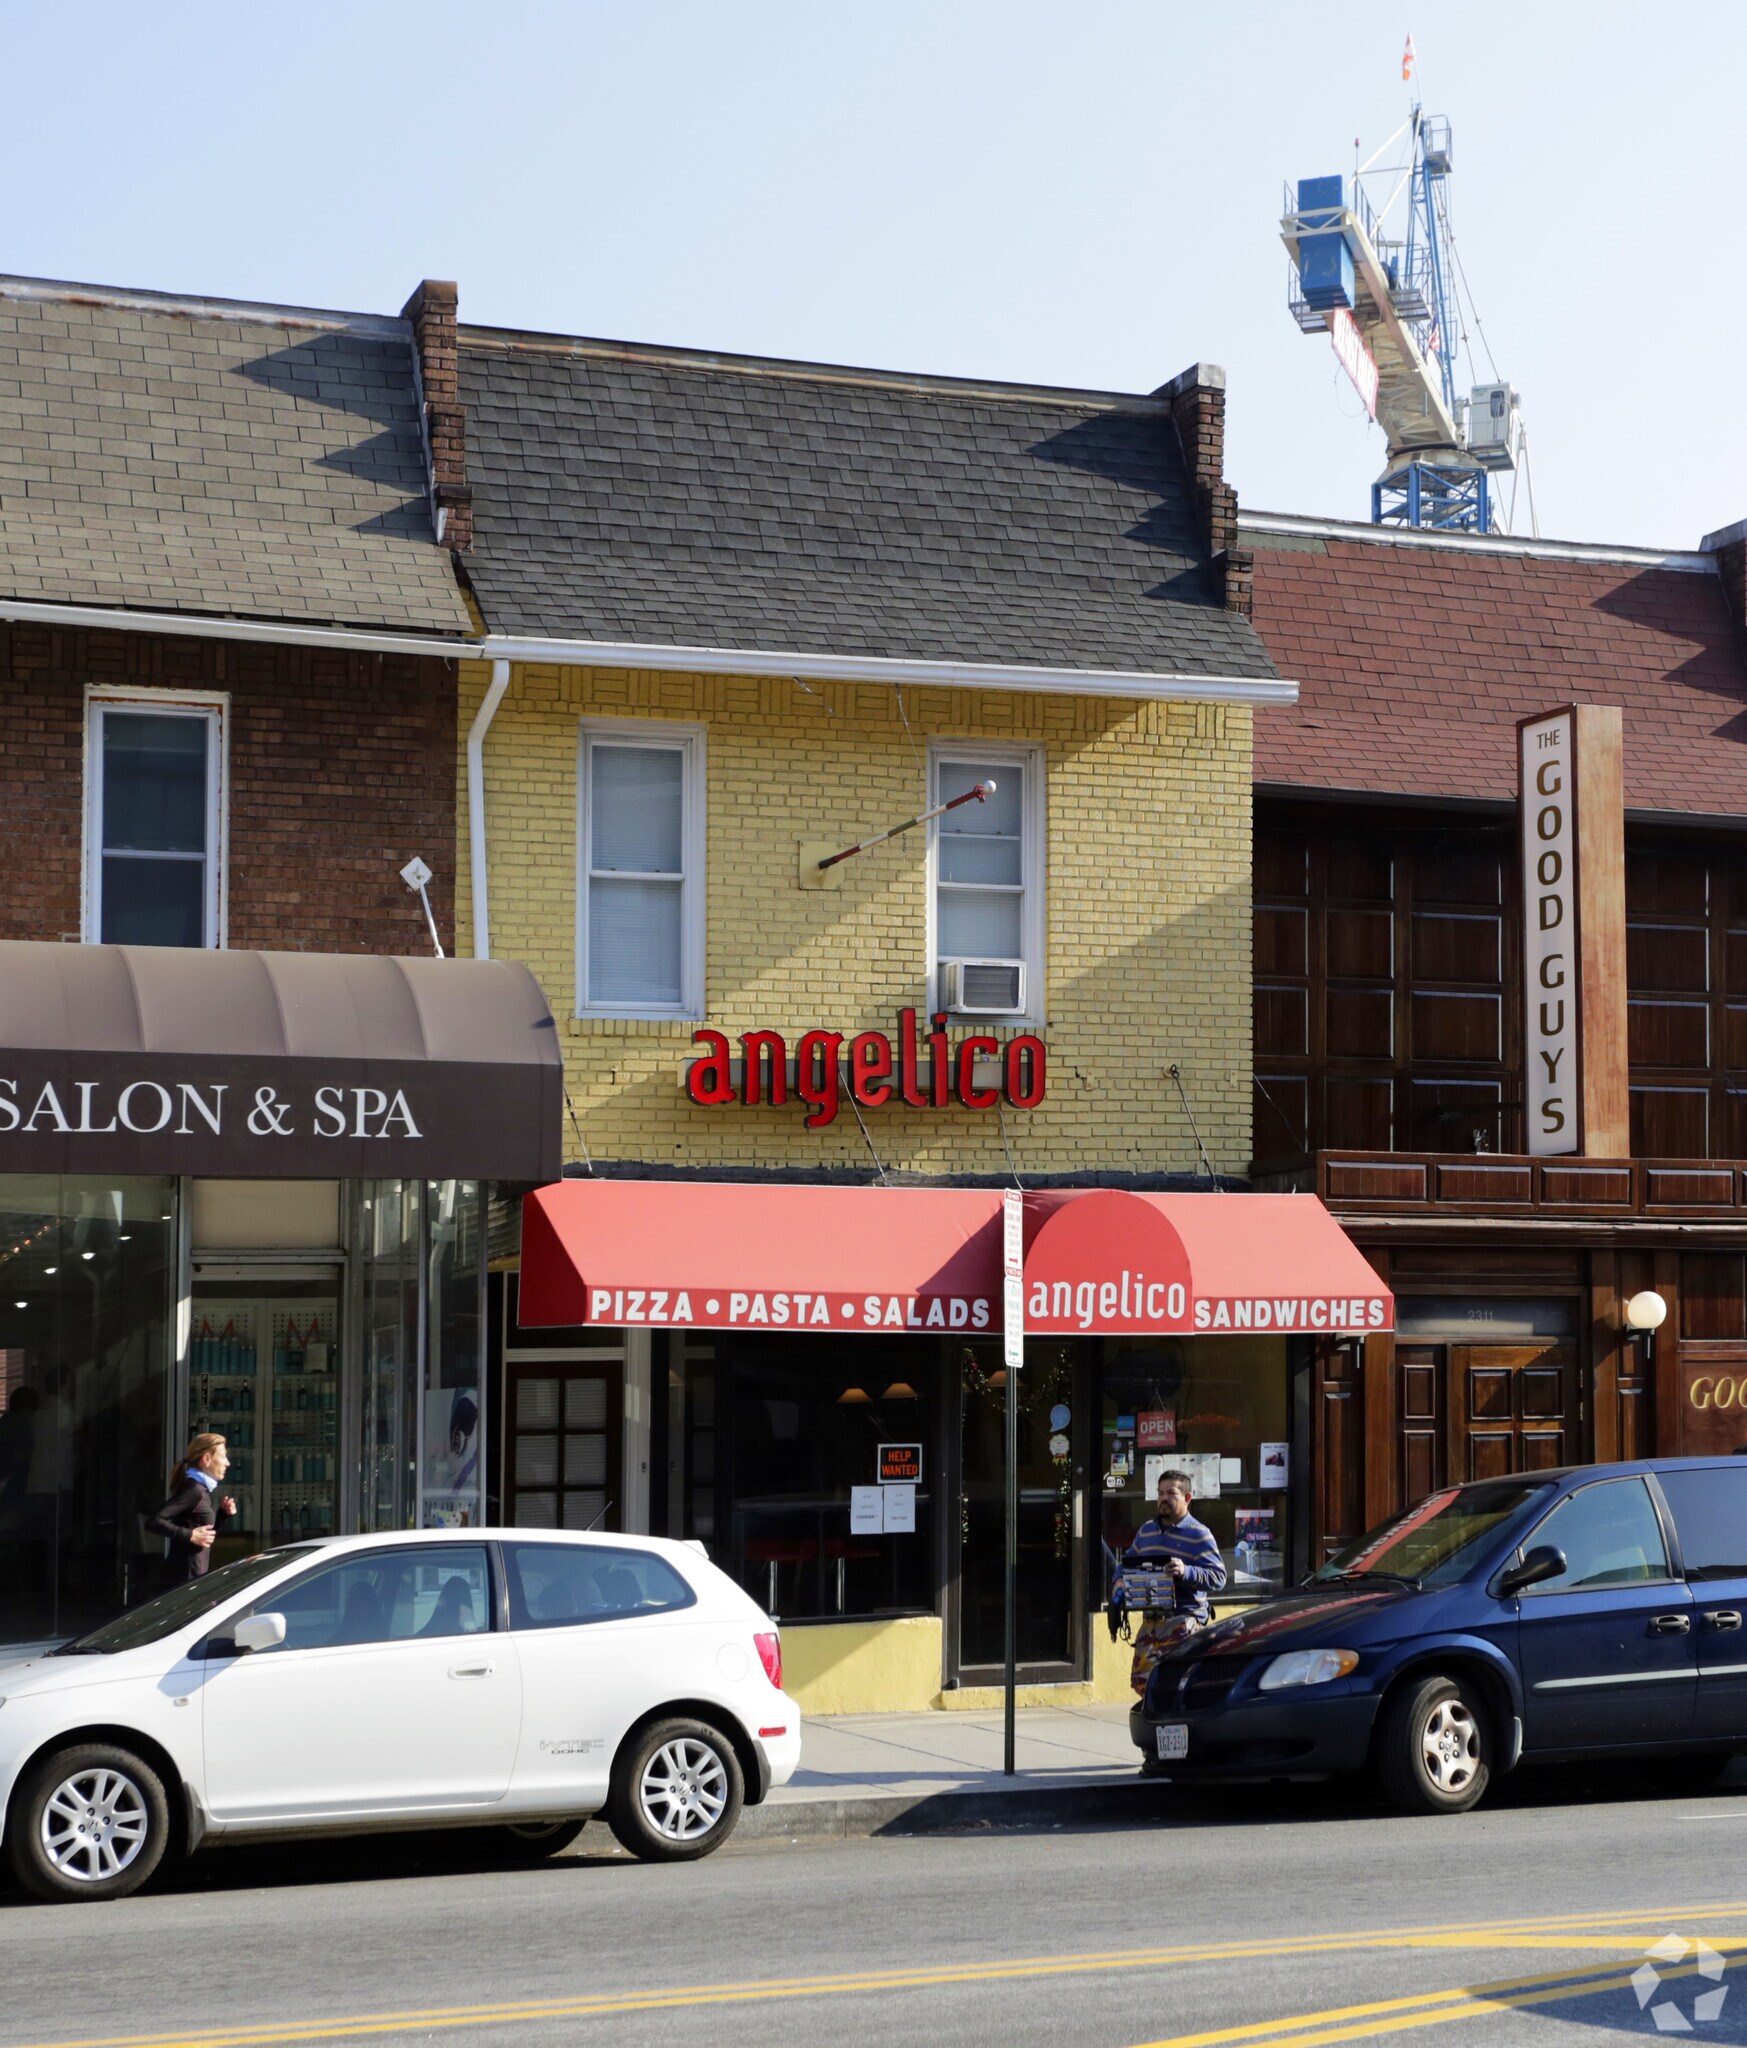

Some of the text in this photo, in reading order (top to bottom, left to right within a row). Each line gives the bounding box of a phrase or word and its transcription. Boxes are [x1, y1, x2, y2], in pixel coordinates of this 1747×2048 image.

[1536, 729, 1560, 749] THE
[1535, 760, 1564, 1133] GOOD GUYS
[687, 1008, 1046, 1128] angelico
[0, 1079, 423, 1138] SALON & SPA
[591, 1289, 693, 1322] PIZZA
[729, 1293, 831, 1325] PASTA
[862, 1295, 990, 1328] SALADS
[1194, 1299, 1384, 1328] SANDWICHES
[1028, 1270, 1185, 1329] angelico
[1467, 1310, 1493, 1323] 2311
[1140, 1420, 1173, 1434] OPEN
[882, 1464, 918, 1476] WANTED
[888, 1450, 911, 1462] HELP
